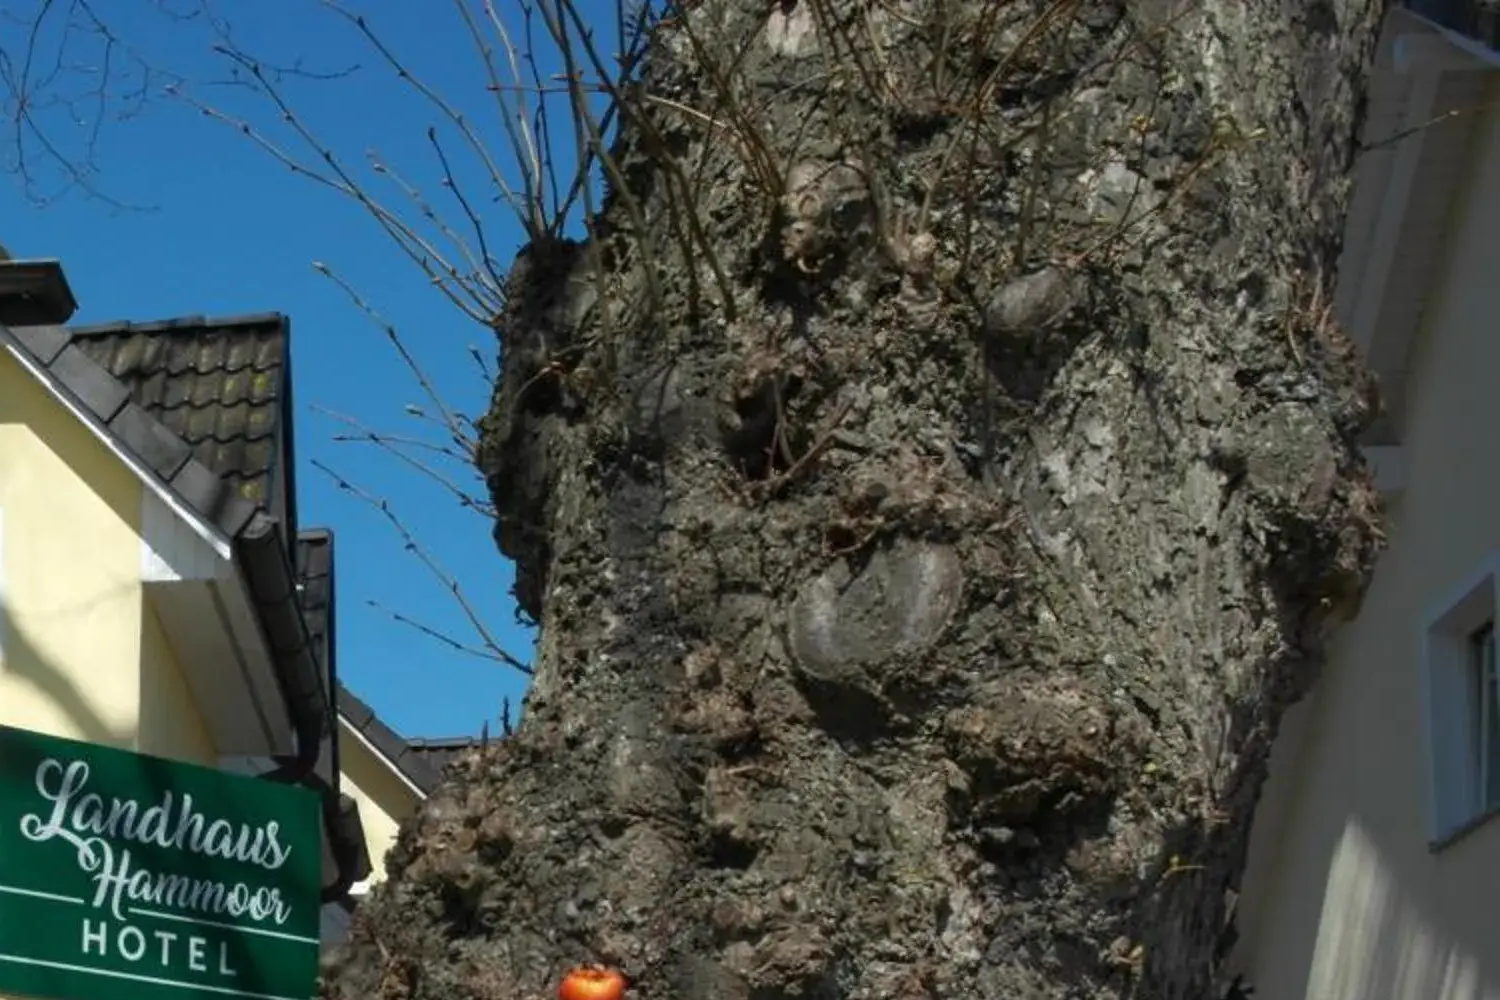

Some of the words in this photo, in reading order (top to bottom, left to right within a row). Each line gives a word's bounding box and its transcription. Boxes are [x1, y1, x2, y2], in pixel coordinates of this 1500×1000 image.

[20, 759, 292, 871] Landhaus
[83, 836, 292, 925] Hammoor
[81, 919, 237, 976] HOTEL
